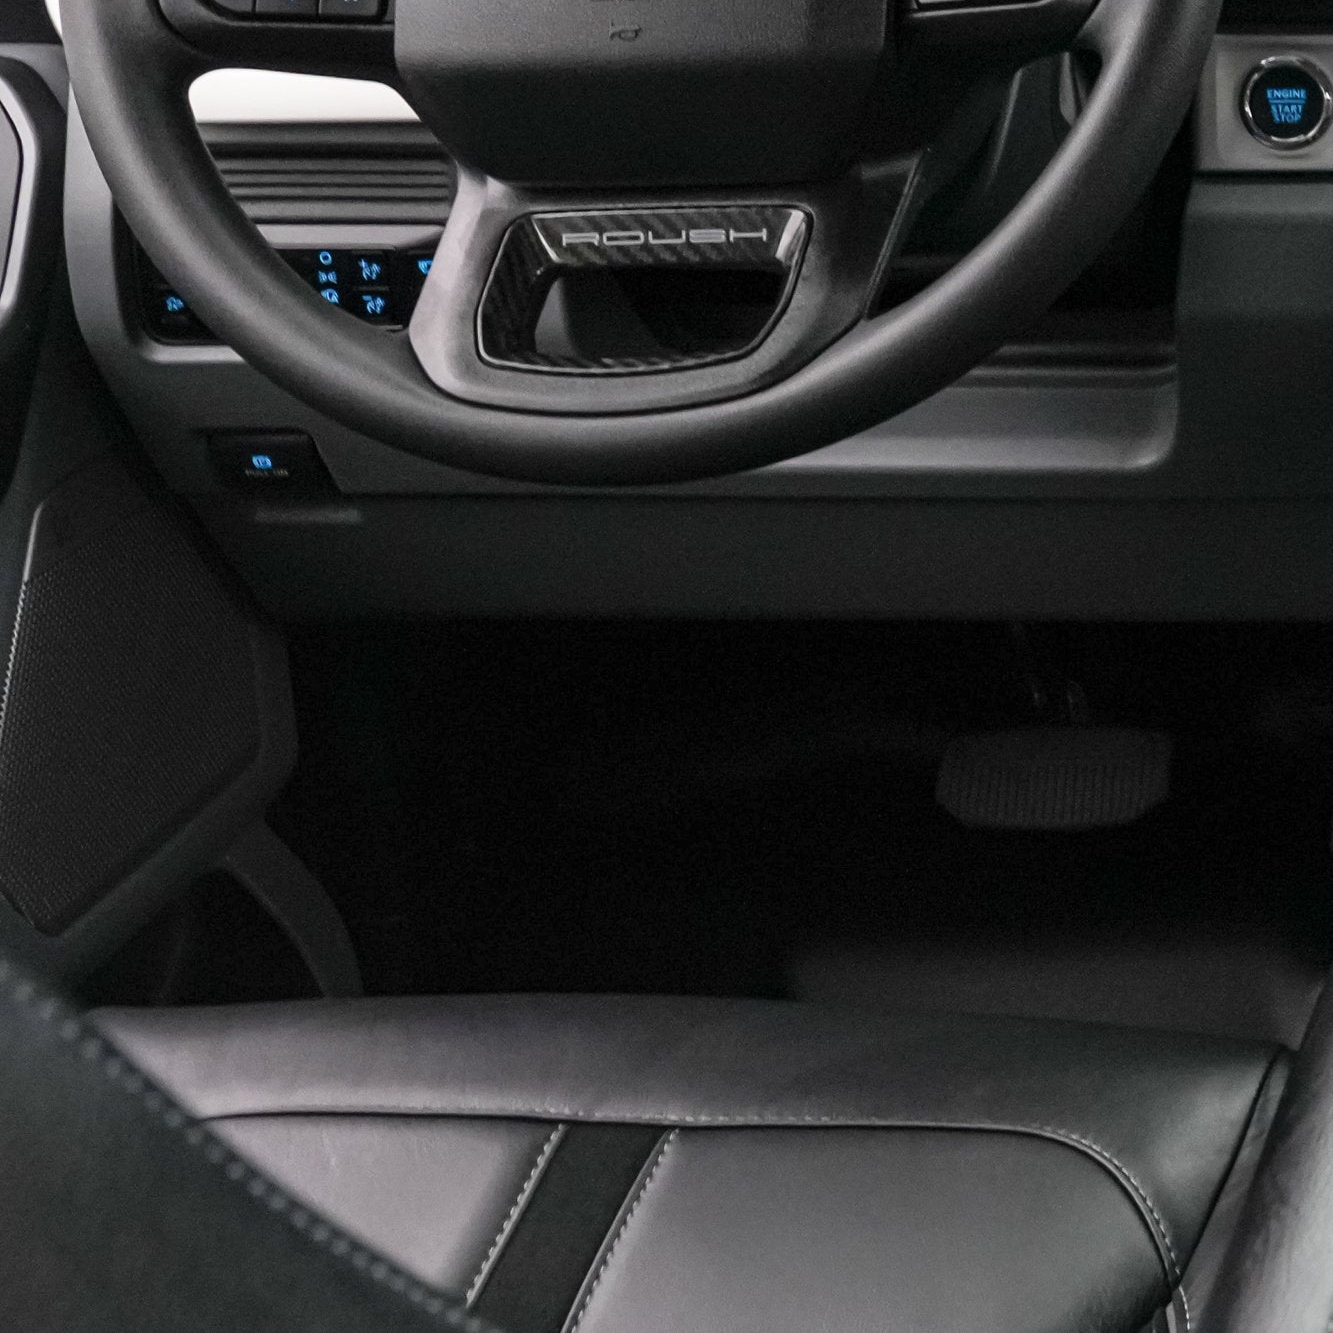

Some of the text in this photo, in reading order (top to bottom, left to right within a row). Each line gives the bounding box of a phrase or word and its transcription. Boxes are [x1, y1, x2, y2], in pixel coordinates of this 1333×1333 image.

[1266, 88, 1307, 99] ENGINE
[1271, 104, 1303, 114] START
[1273, 113, 1302, 123] STOP
[562, 228, 767, 247] ROUSH
